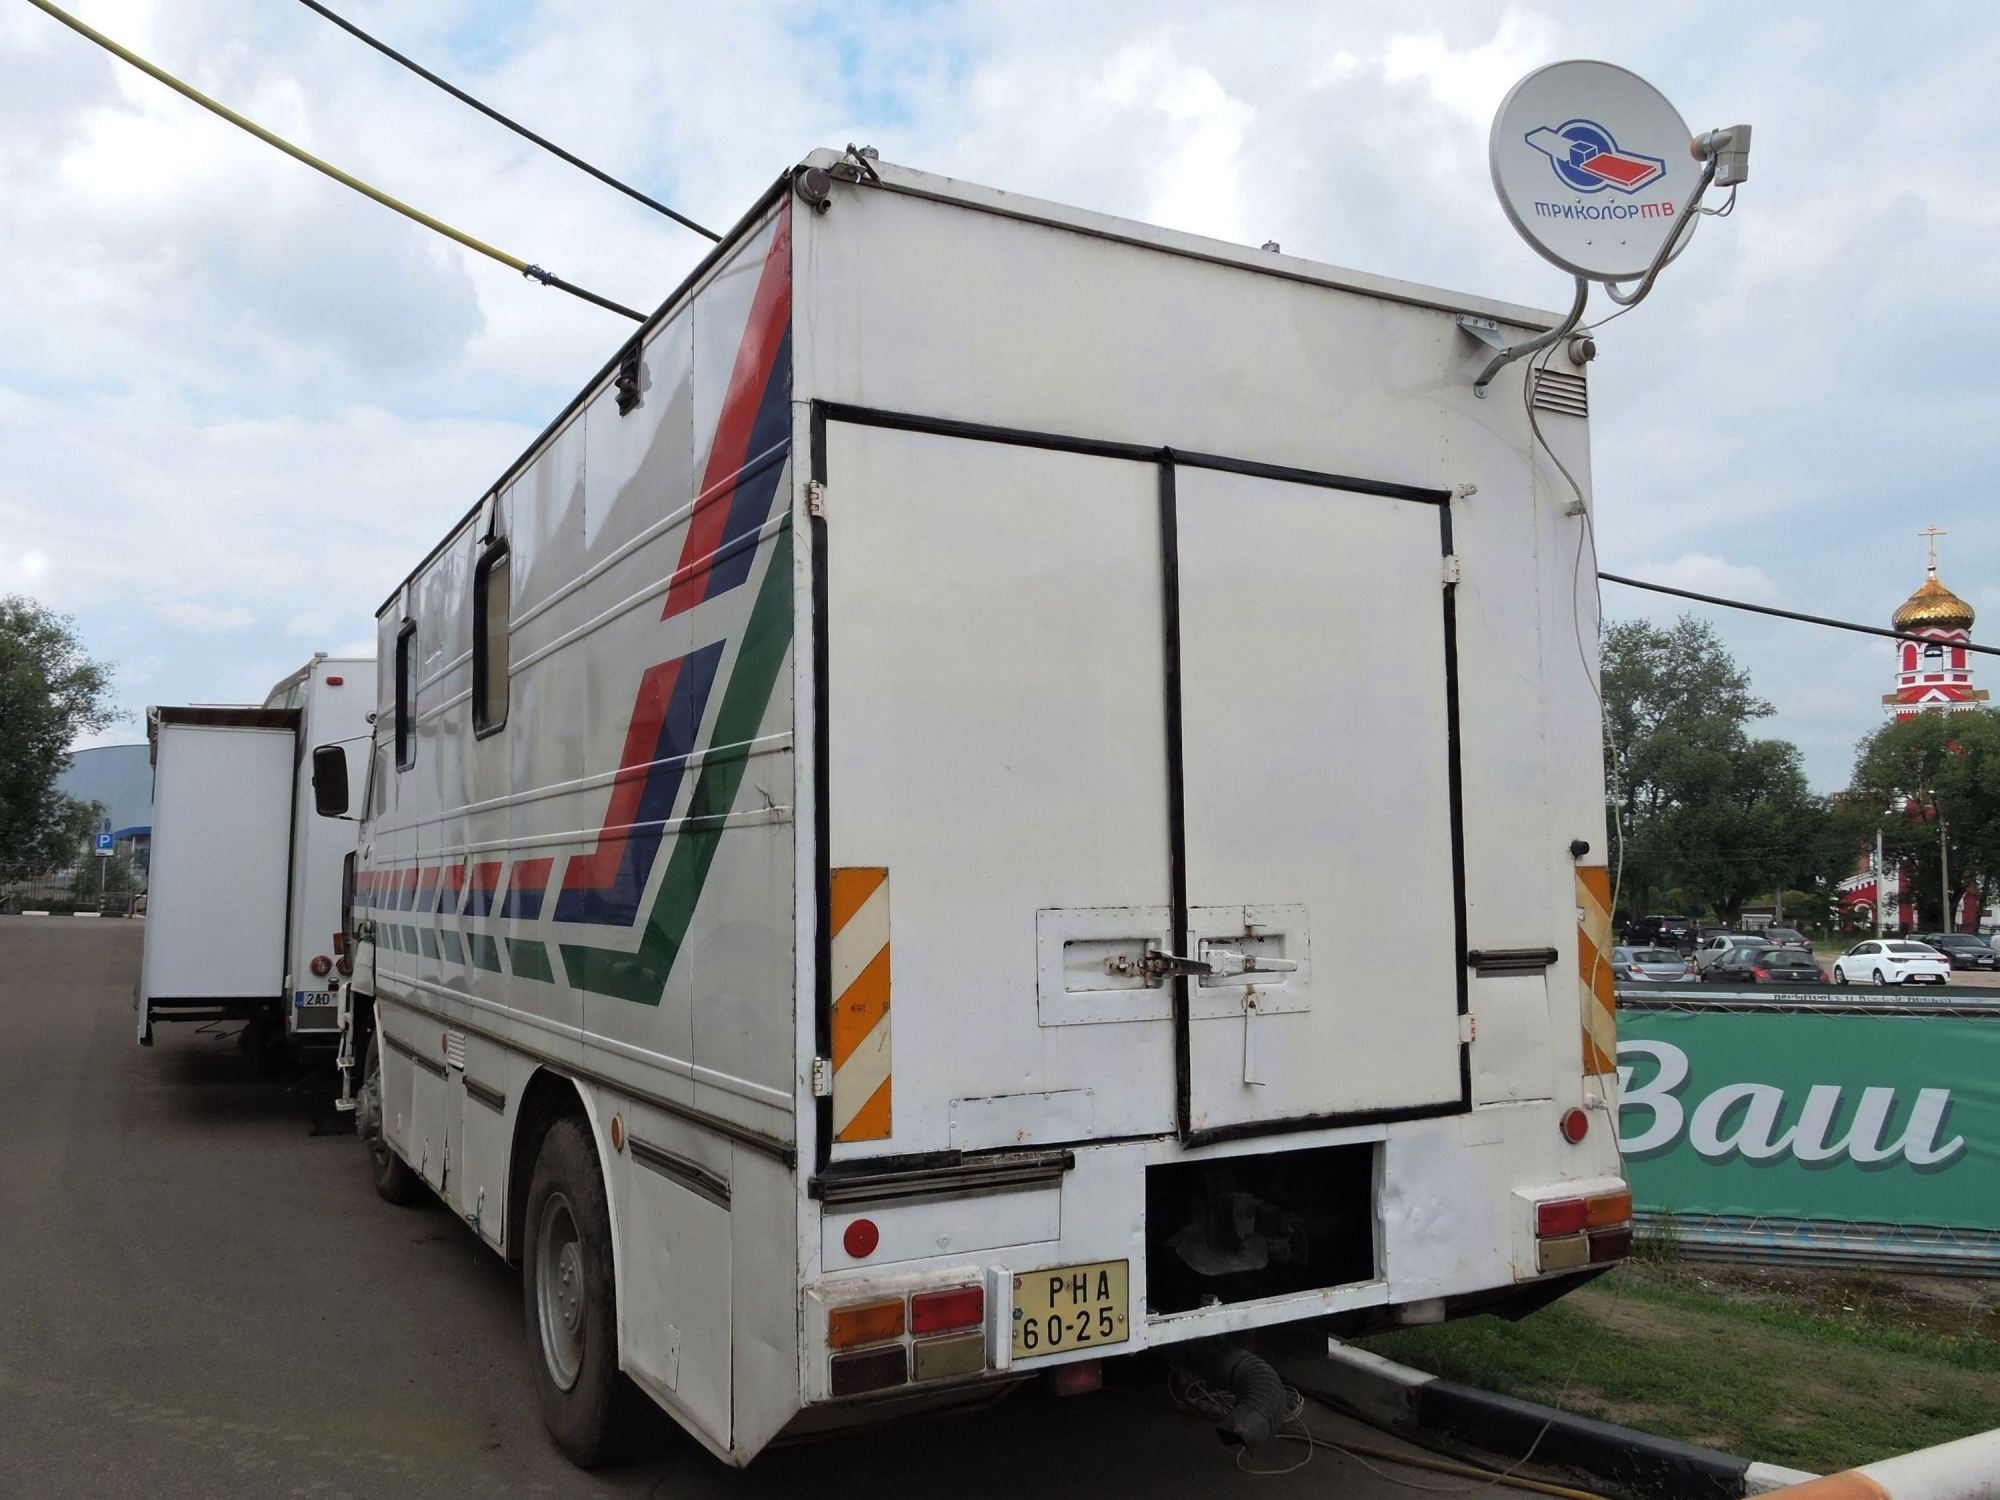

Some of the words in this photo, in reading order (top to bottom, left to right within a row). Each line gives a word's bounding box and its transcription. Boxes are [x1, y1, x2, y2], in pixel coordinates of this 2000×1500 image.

[99, 834, 111, 848] P
[1616, 1038, 1965, 1167] Ваш
[1049, 1270, 1110, 1308] PHA
[1023, 1306, 1114, 1350] 60-25
